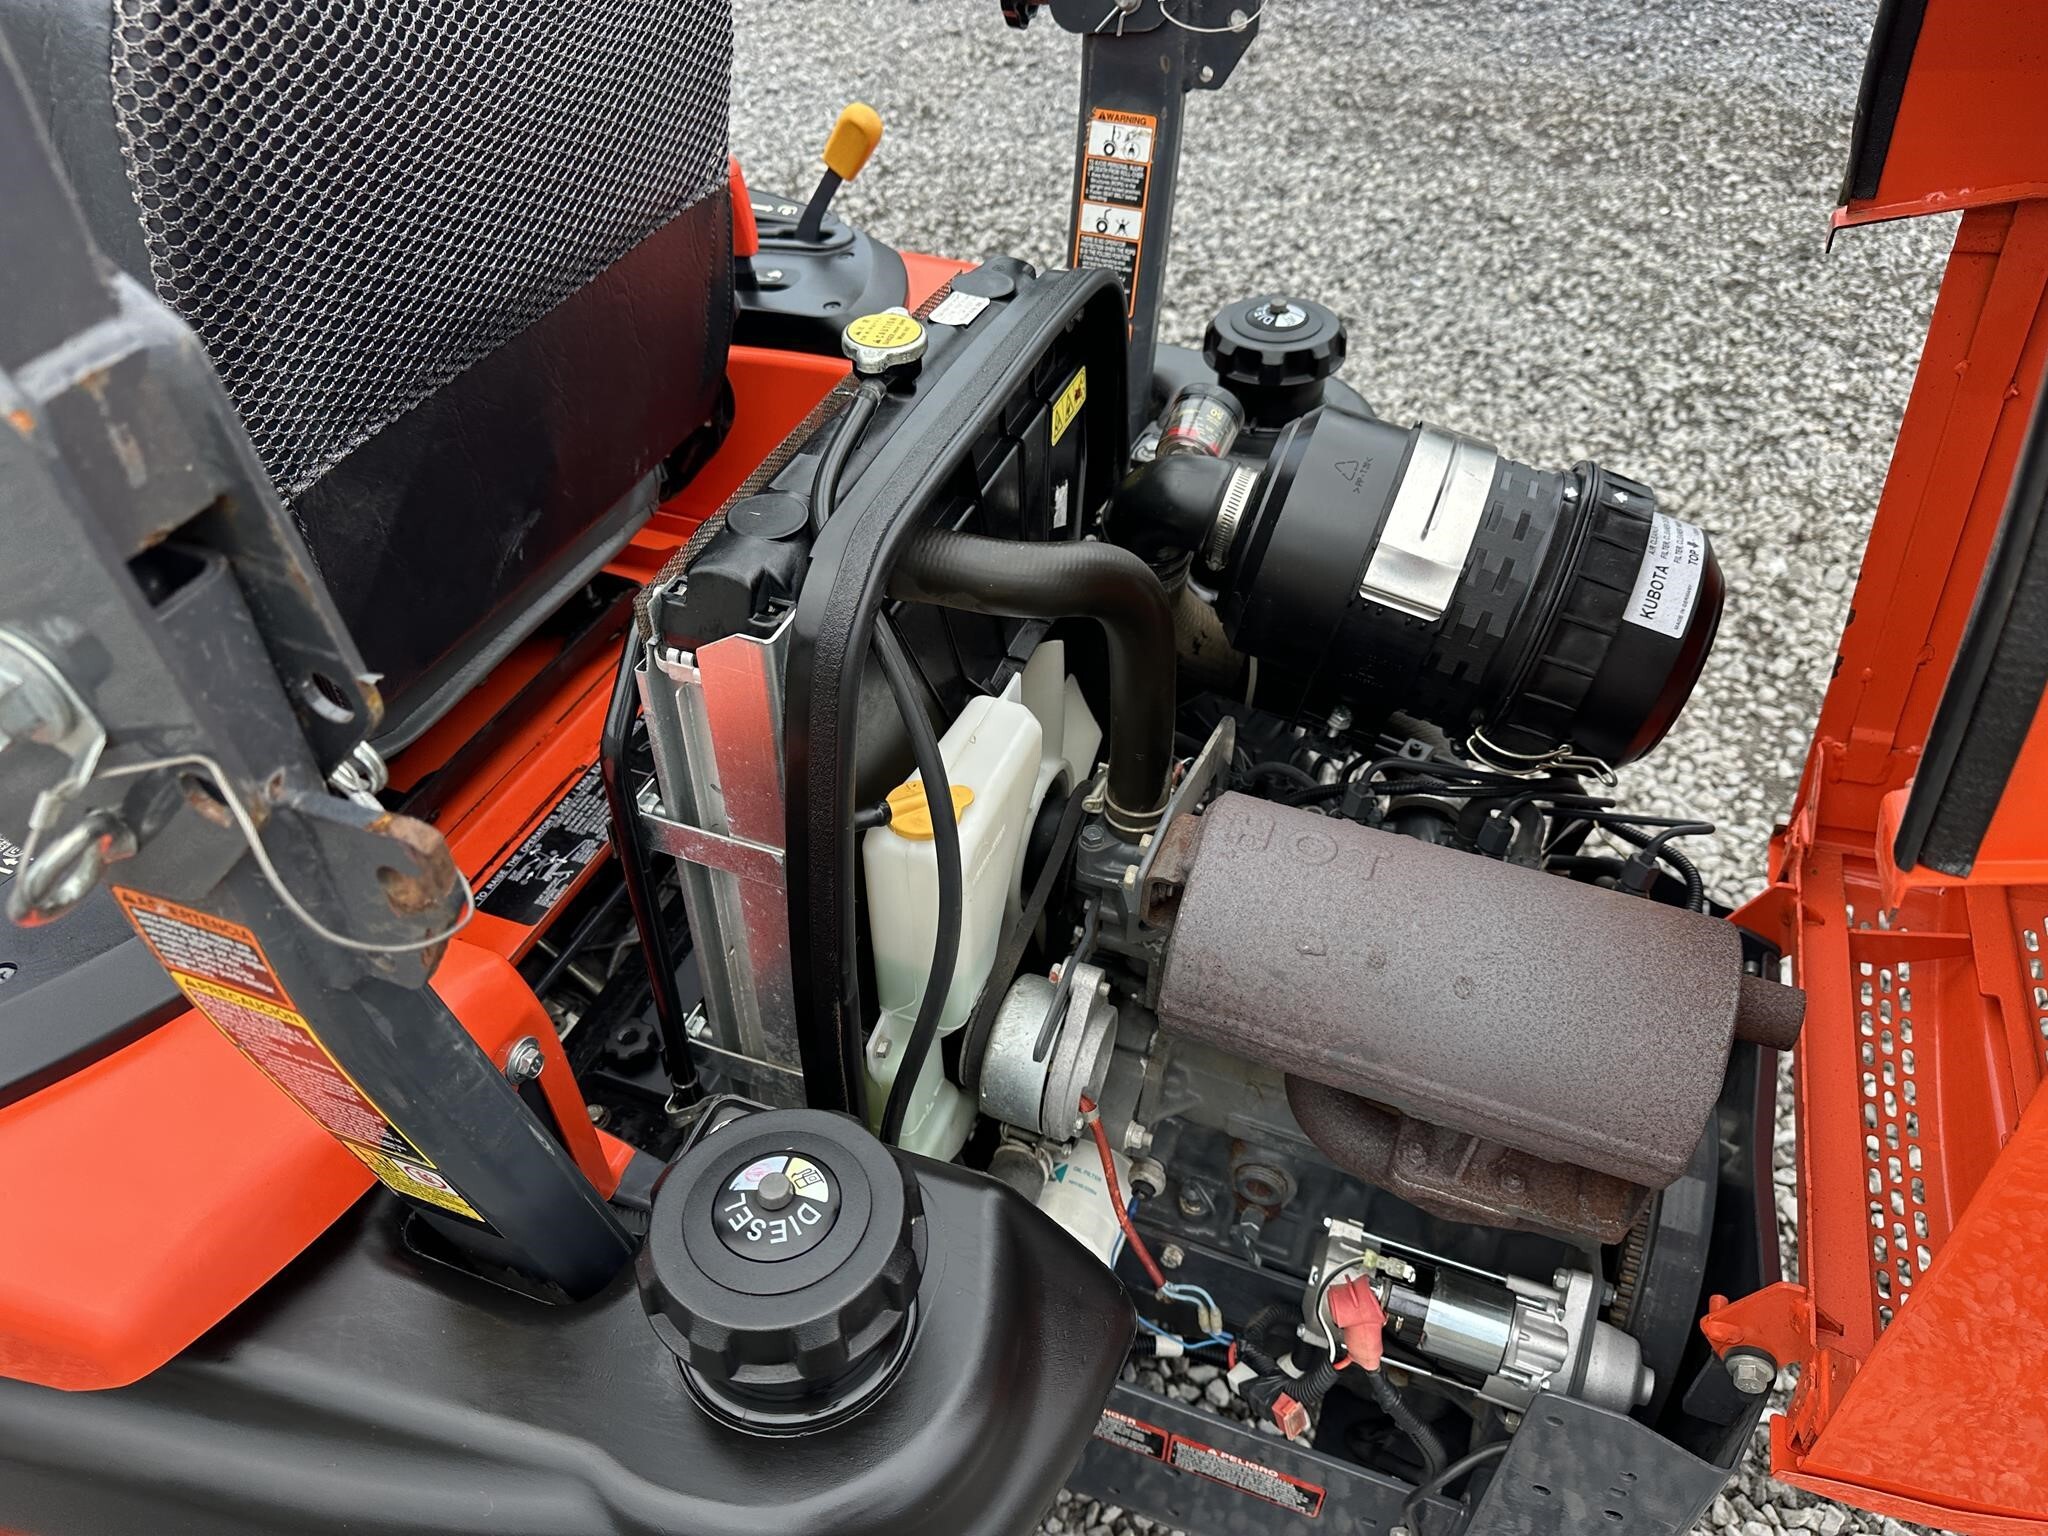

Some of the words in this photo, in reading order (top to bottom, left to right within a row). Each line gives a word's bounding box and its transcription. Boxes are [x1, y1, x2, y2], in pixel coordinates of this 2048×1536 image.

[1106, 113, 1147, 126] WARNING
[1688, 549, 1700, 566] TOP
[1640, 565, 1669, 620] KUBOTA
[475, 891, 488, 901] TO
[506, 853, 522, 868] THE
[724, 1192, 822, 1244] DIESEL
[1103, 1408, 1136, 1425] NGER
[1220, 1451, 1279, 1477] PELIGRO
